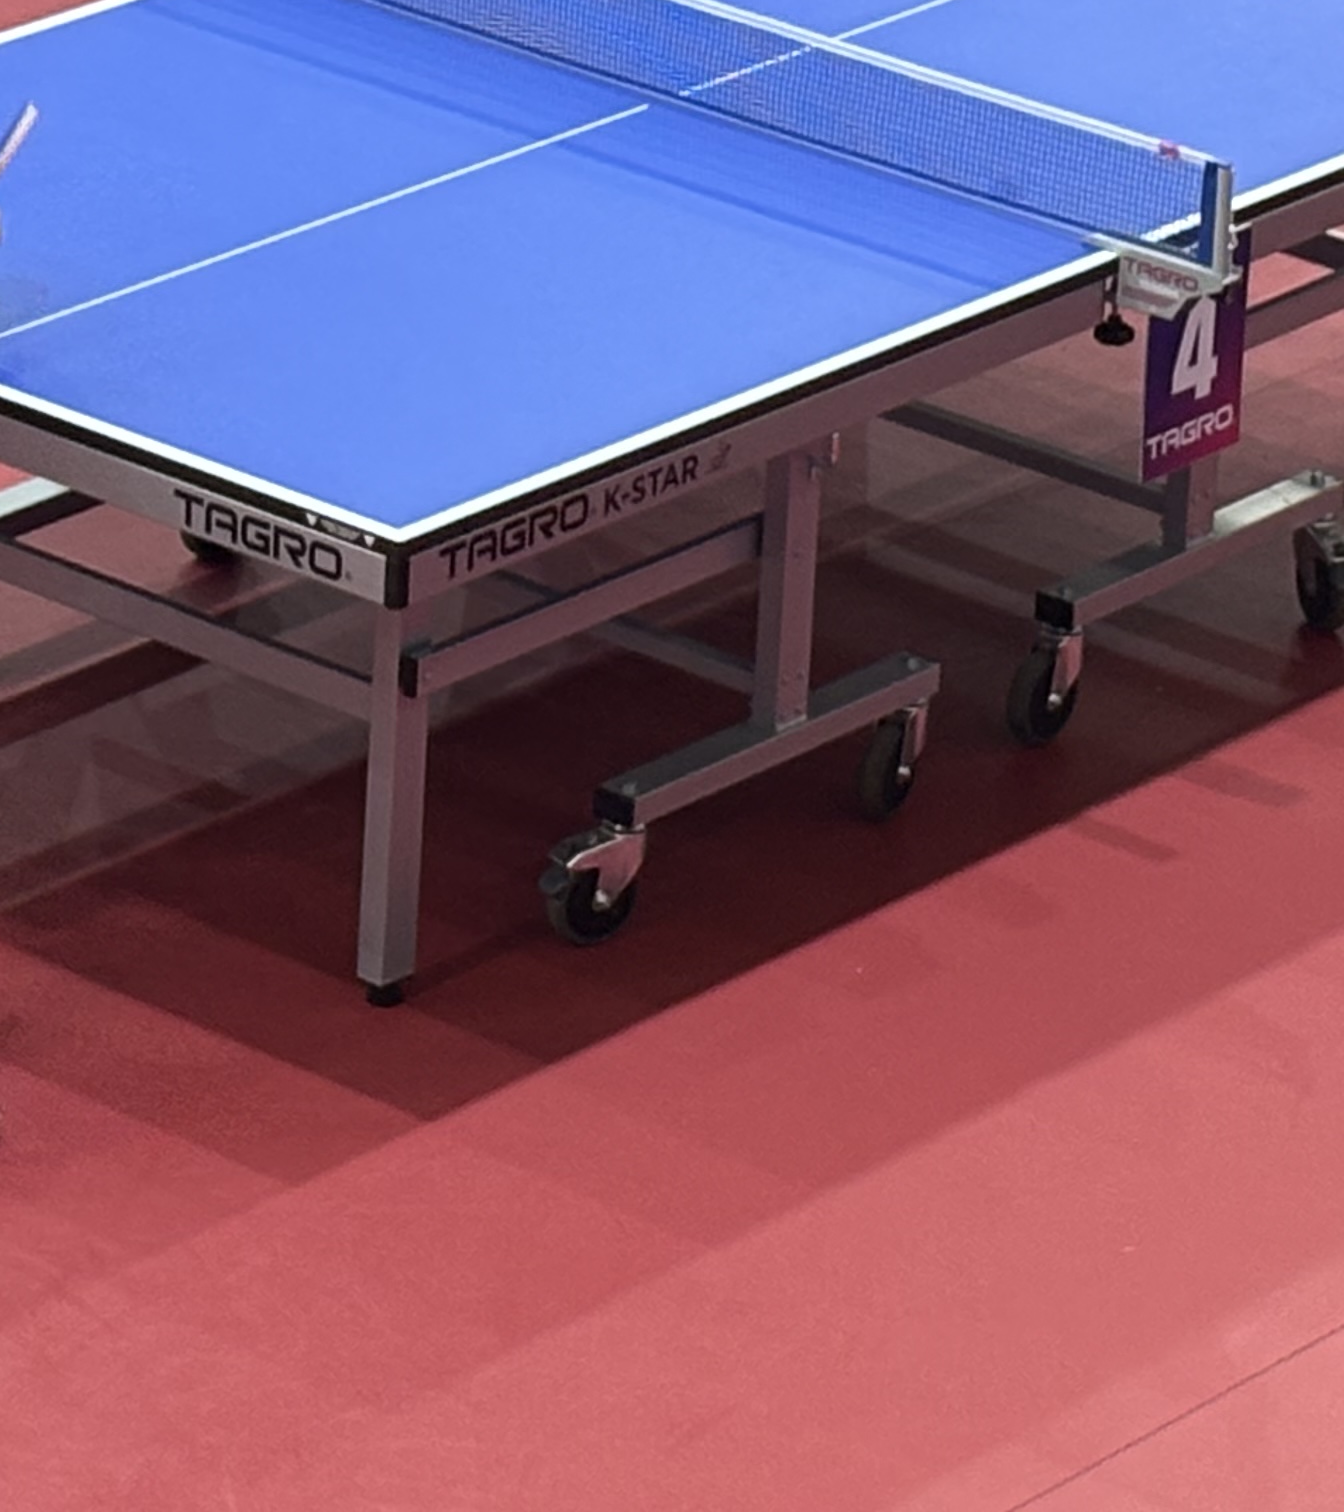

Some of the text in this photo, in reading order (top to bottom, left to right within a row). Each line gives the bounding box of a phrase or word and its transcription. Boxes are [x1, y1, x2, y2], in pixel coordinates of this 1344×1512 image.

[1122, 257, 1199, 292] TAGRO
[1170, 294, 1219, 401] 4
[1146, 403, 1234, 461] TAGRO
[174, 488, 343, 581] TAGRO
[439, 454, 699, 579] TAGRO K-STAR
